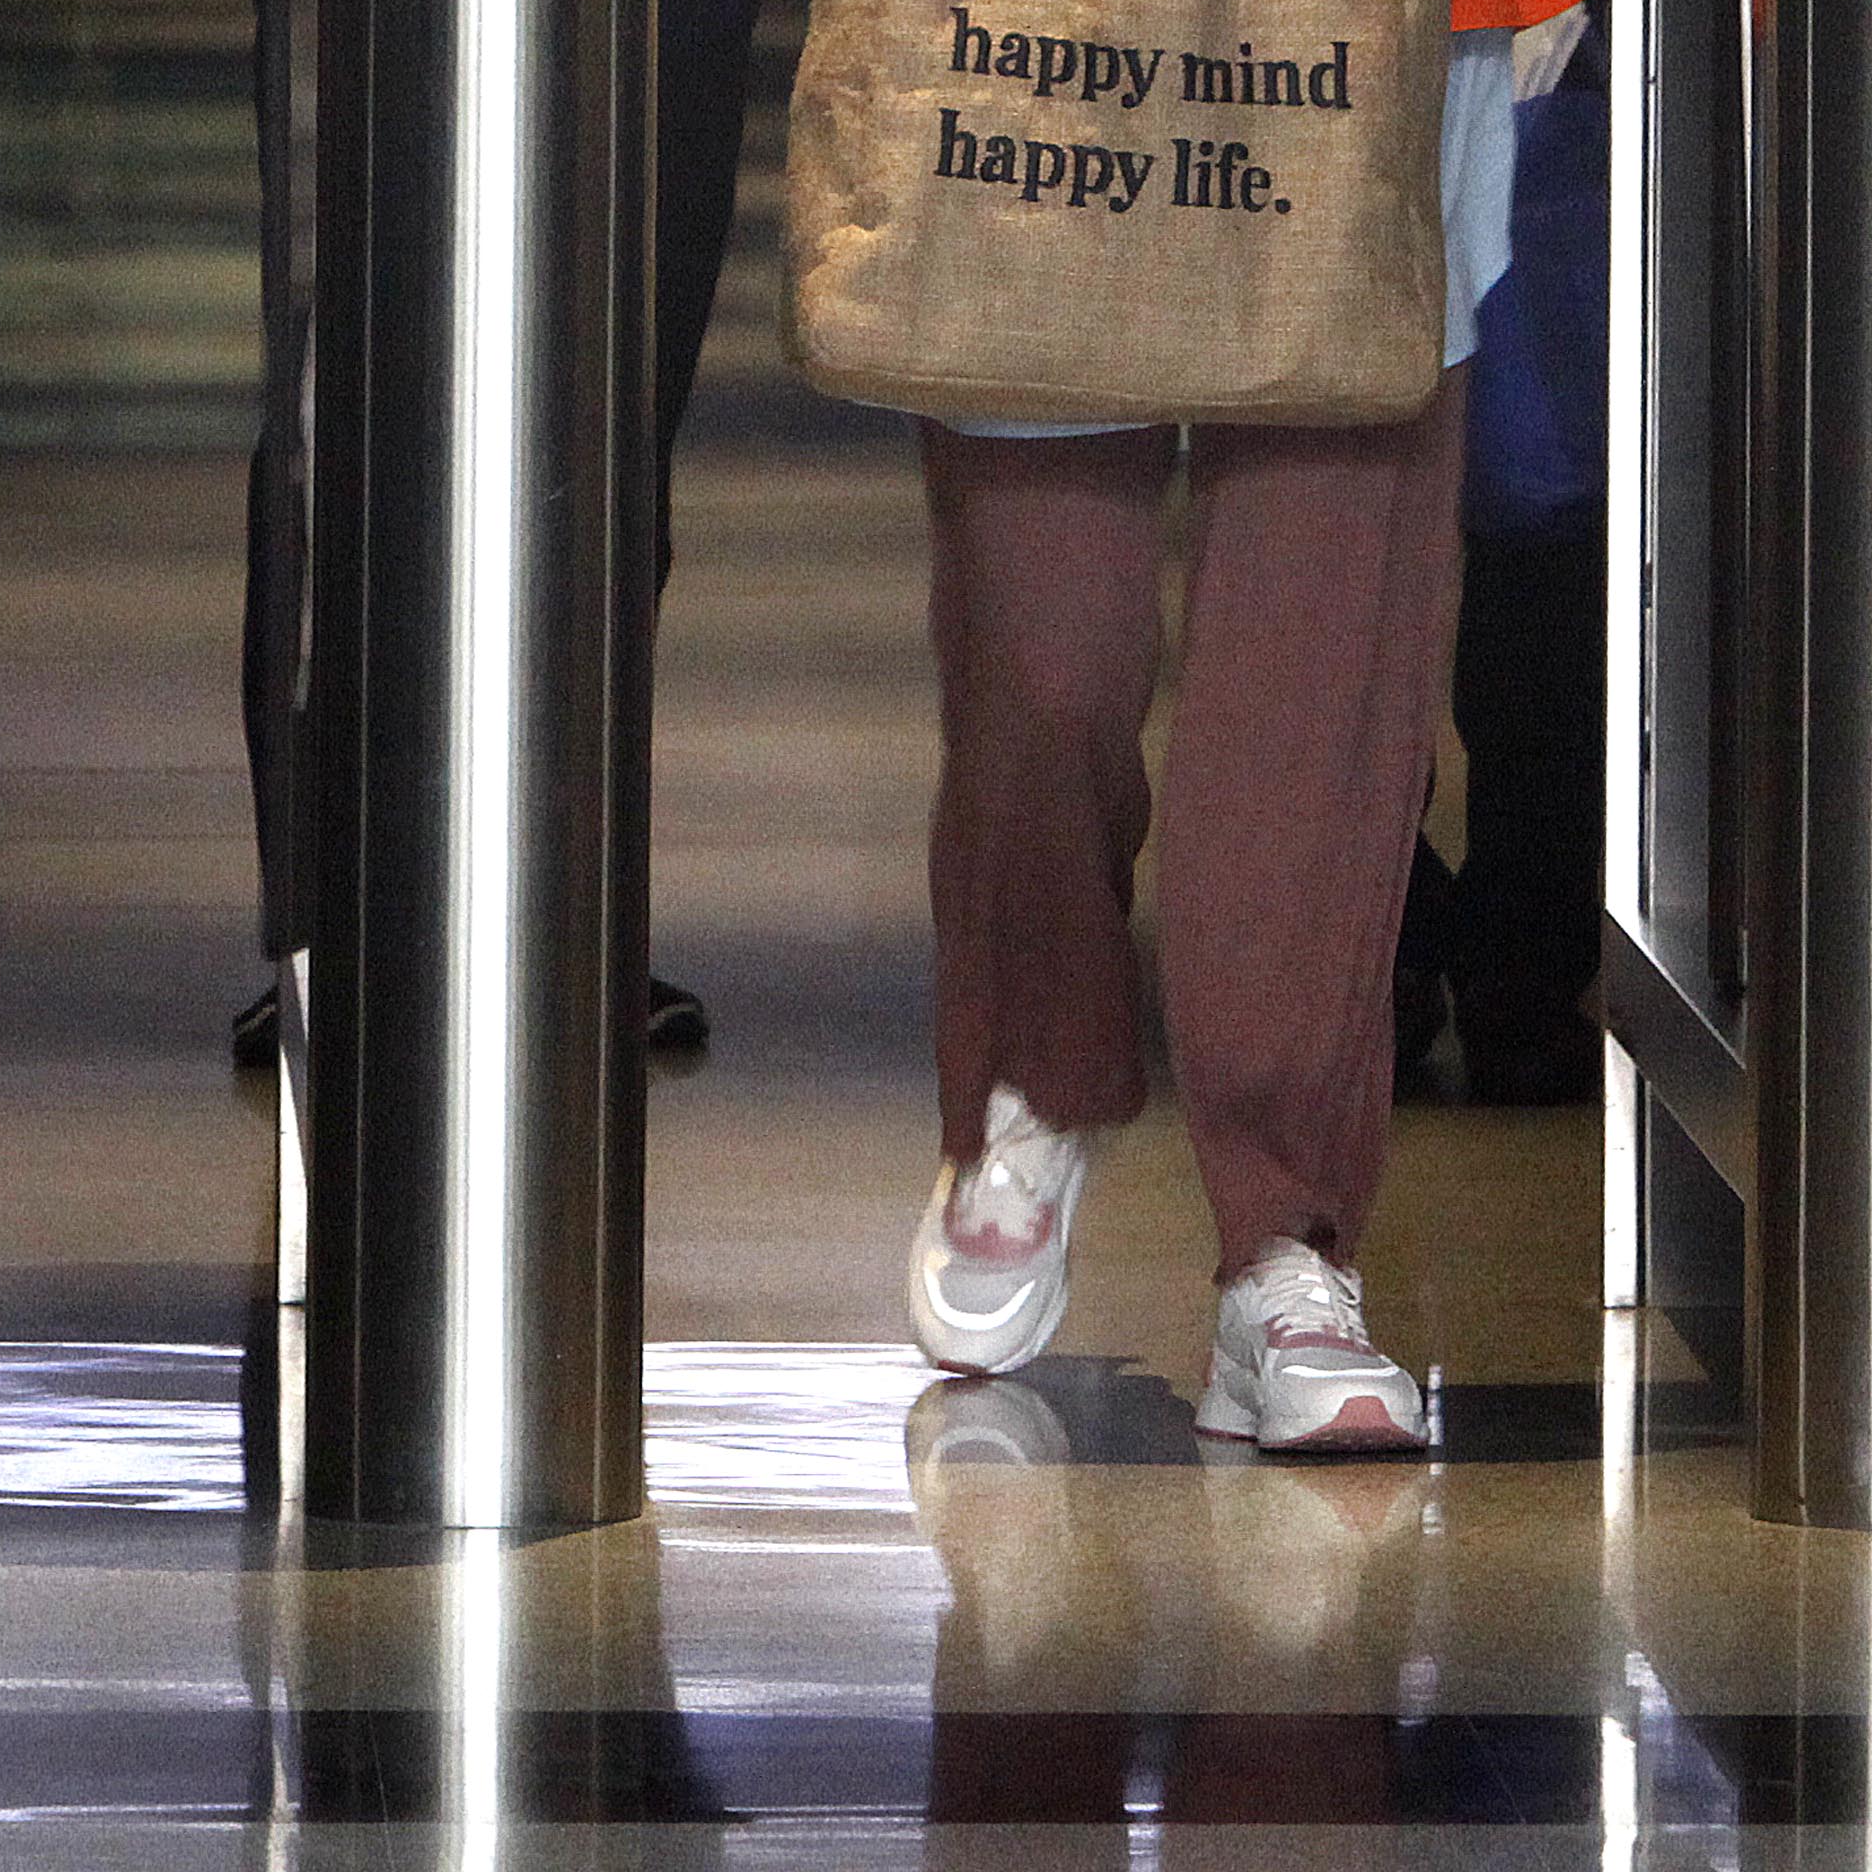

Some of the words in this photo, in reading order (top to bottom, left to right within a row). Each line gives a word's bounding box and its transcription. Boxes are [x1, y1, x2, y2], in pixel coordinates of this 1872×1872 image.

[949, 6, 1164, 109] happy
[1180, 40, 1353, 110] mind
[933, 108, 1155, 214] happy
[1170, 137, 1293, 215] life.
